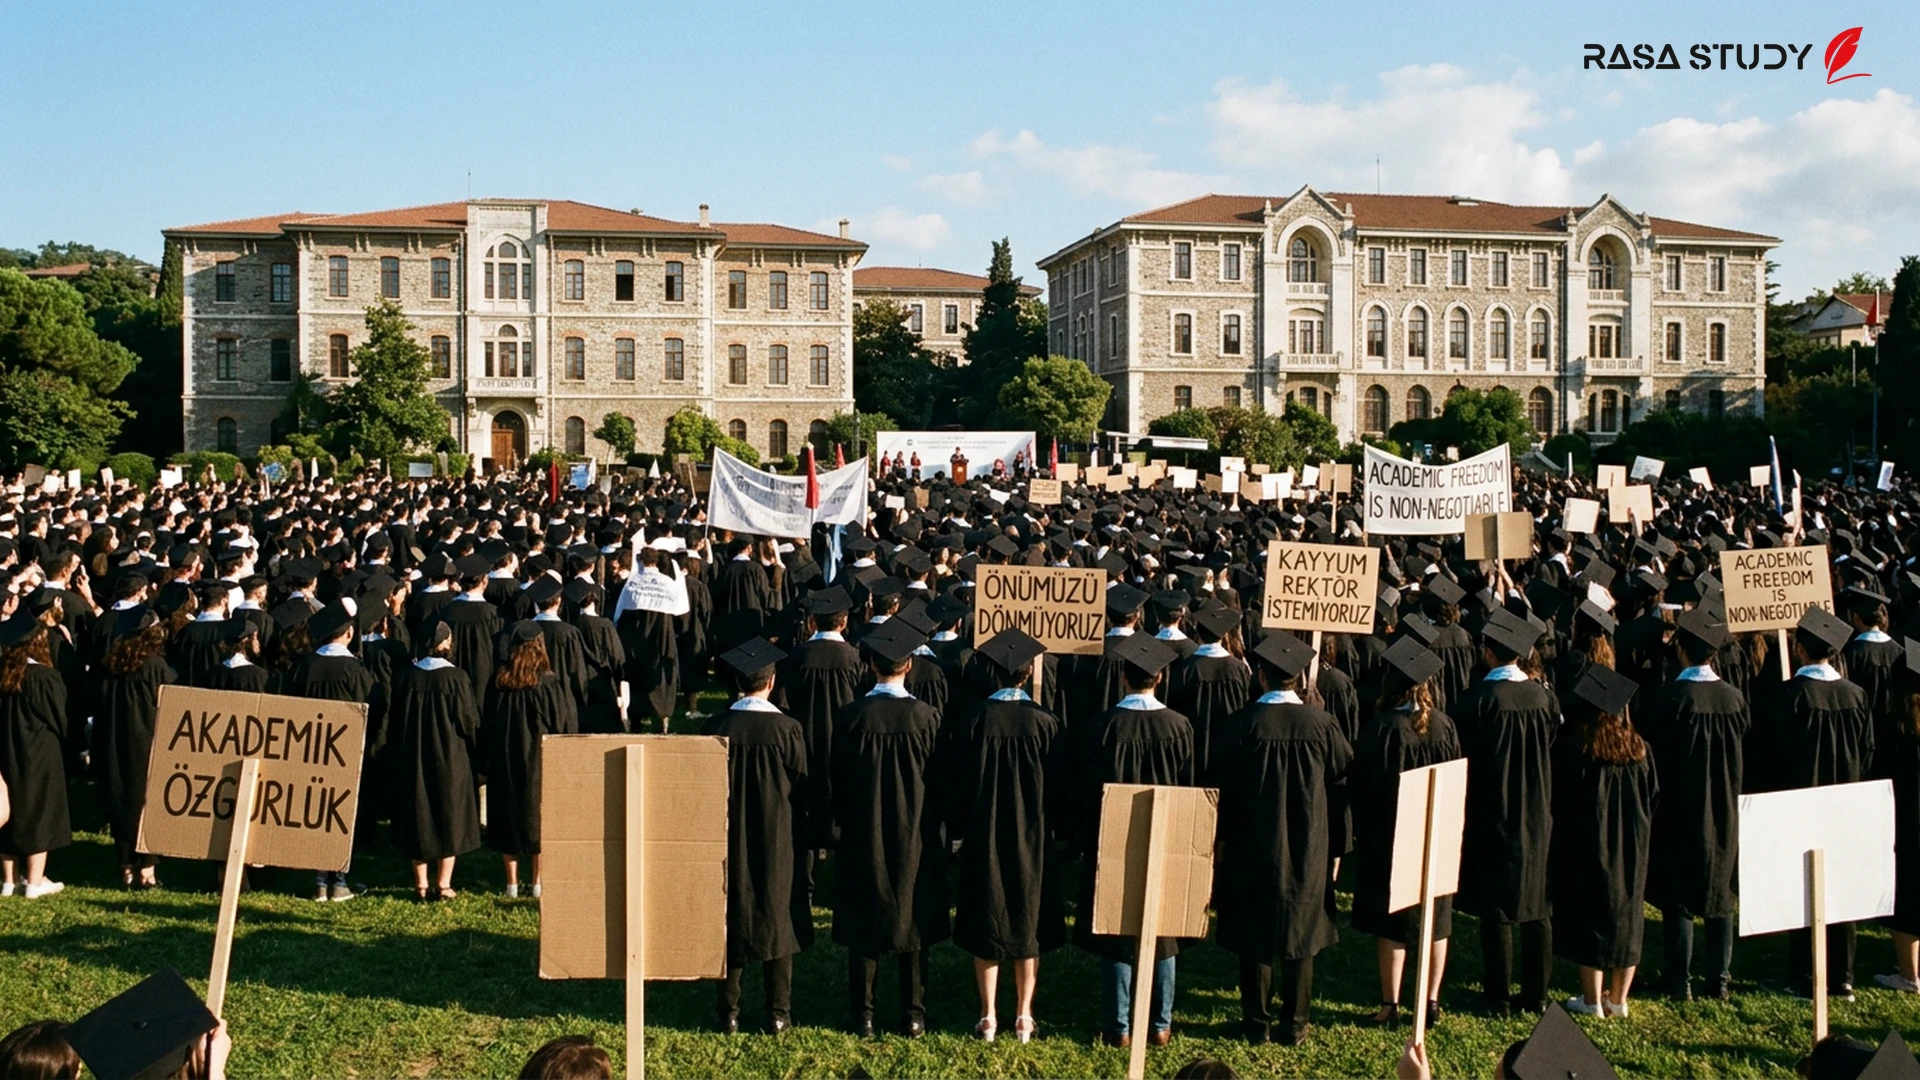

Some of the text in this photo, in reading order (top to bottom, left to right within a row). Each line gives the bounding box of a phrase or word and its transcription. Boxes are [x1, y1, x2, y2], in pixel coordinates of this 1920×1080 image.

[1369, 459, 1504, 488] ACADEMIC FREEDOM
[1369, 491, 1383, 518] IS
[1278, 549, 1367, 575] KAYYUM
[984, 569, 1098, 604] ÖNÜMÜZÜ
[1772, 588, 1787, 602] IS
[978, 604, 1103, 641] DÖNMÜYORUZ
[1267, 595, 1371, 625] İSTEMİYORUZ
[167, 709, 348, 767] AKADEMİK
